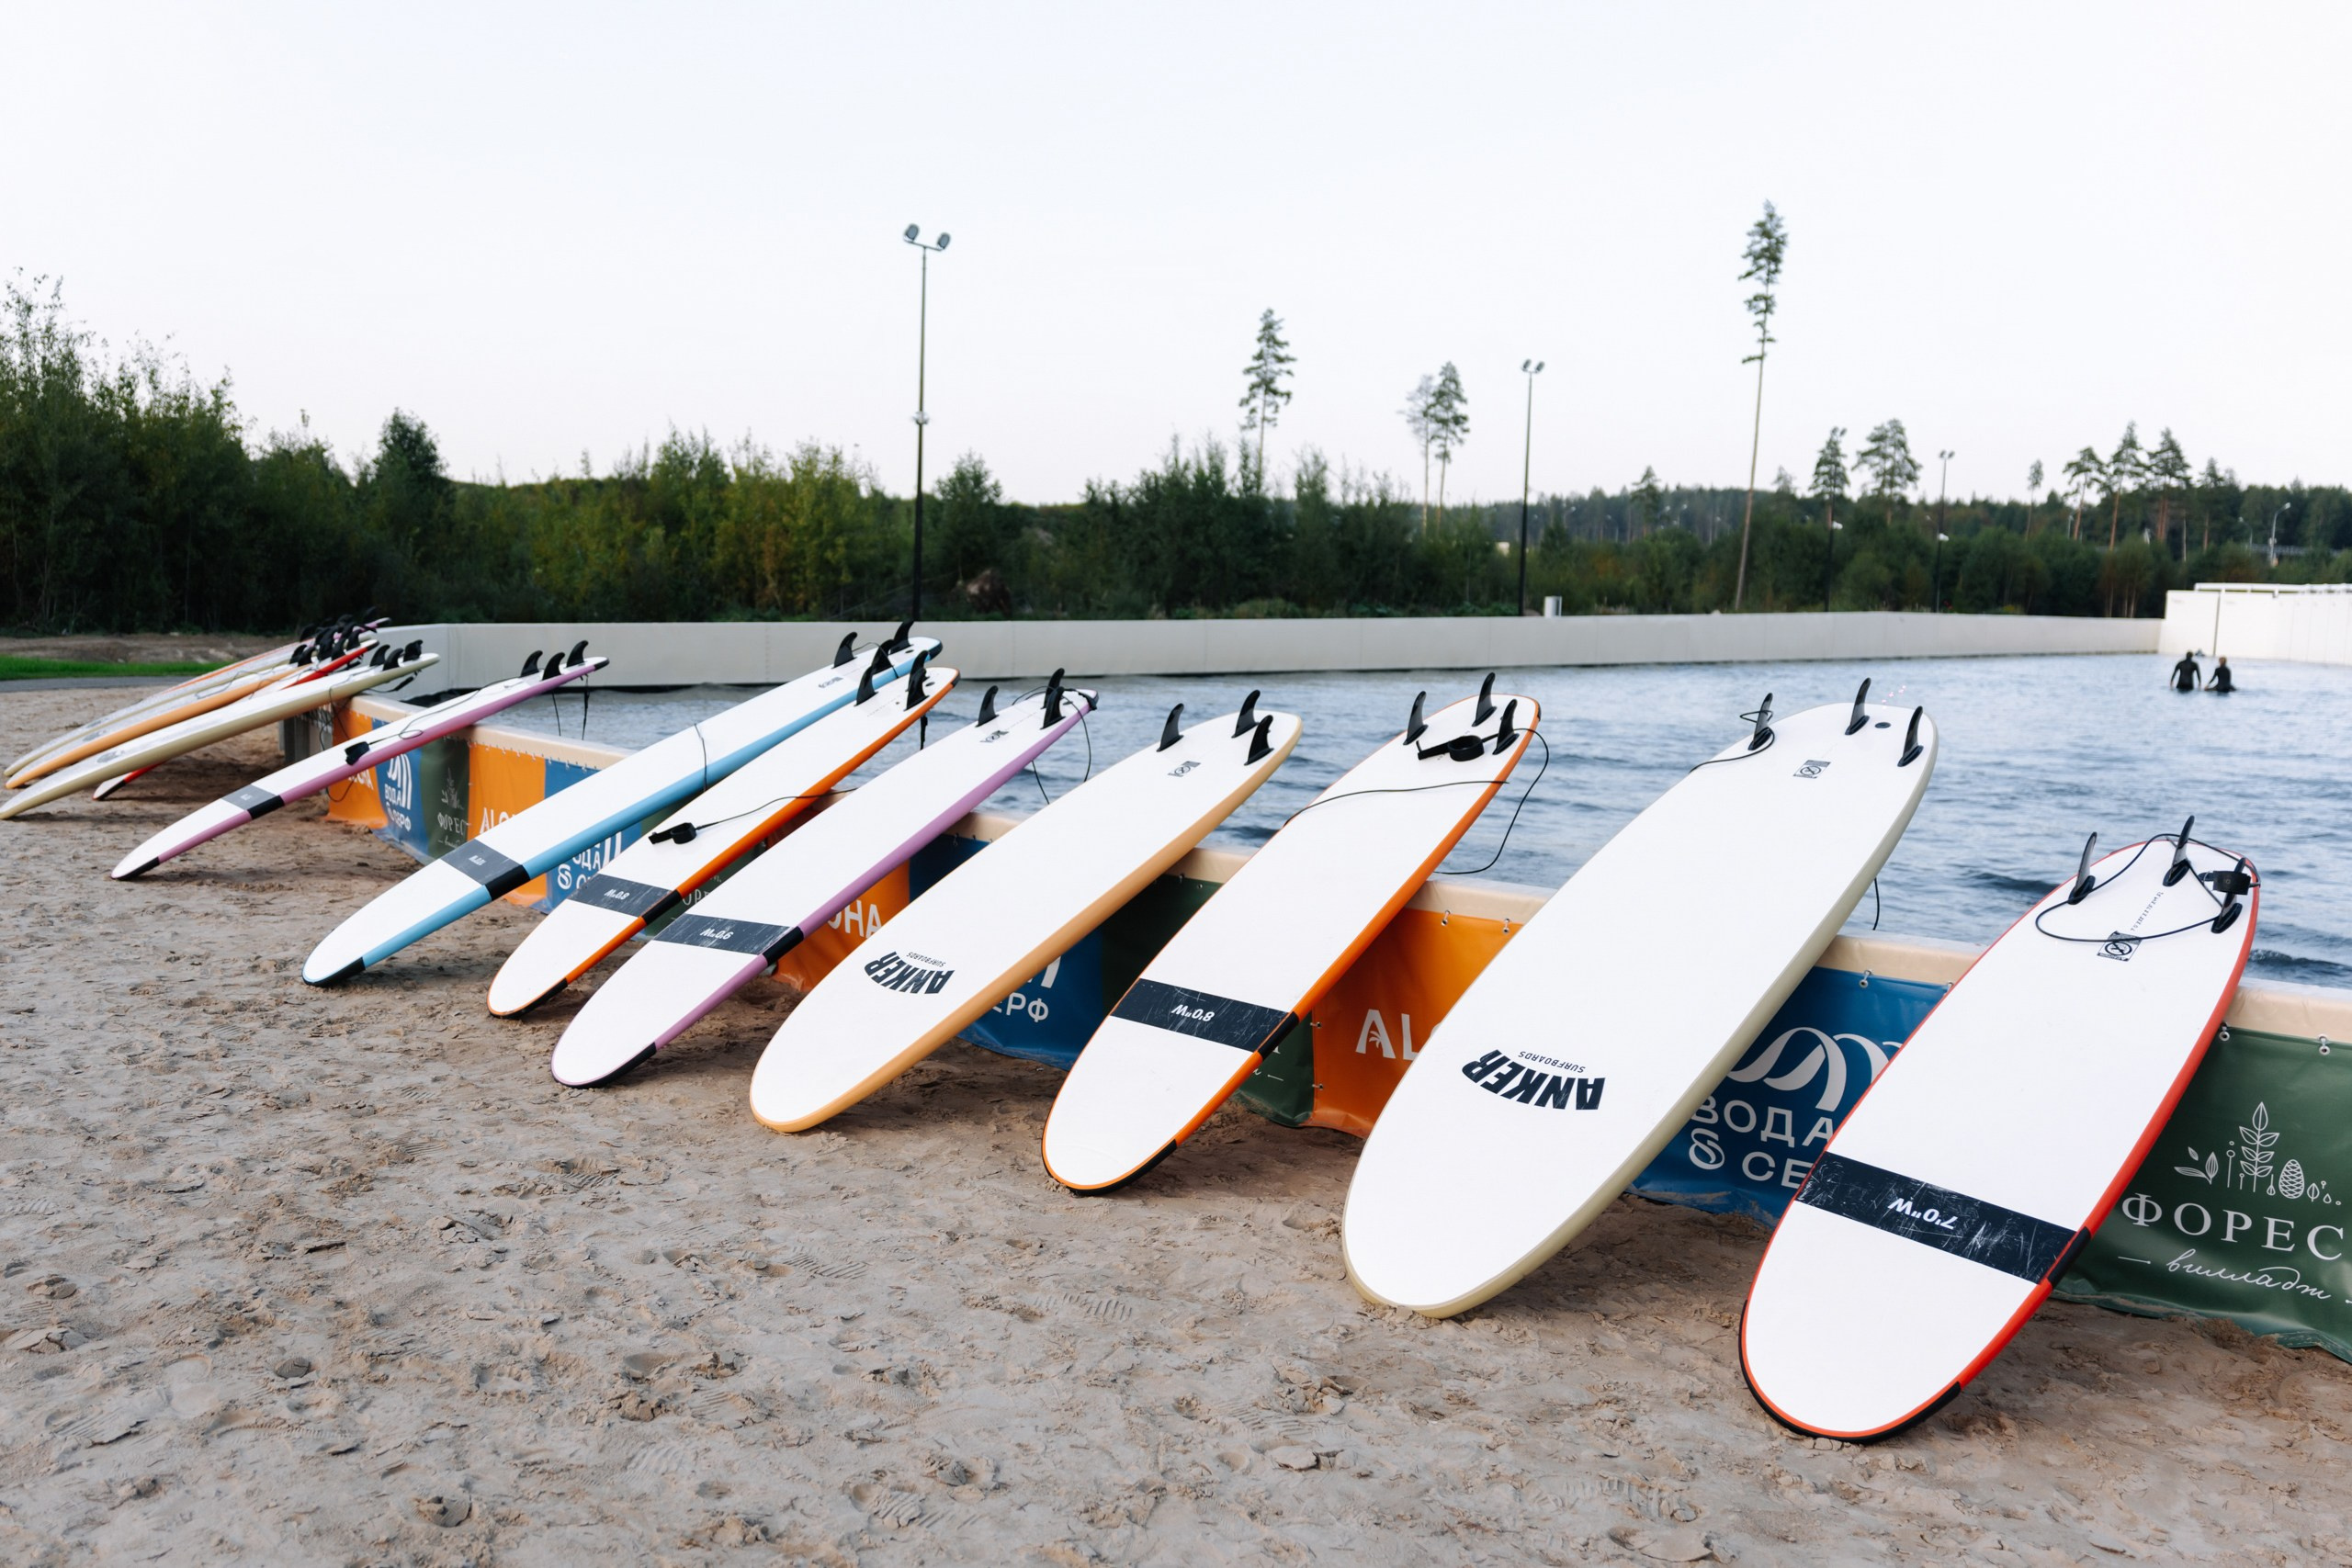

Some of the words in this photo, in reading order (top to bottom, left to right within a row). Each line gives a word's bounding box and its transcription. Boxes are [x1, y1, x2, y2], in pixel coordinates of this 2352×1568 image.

[864, 952, 956, 995] ANKER
[905, 951, 947, 968] SURFBOARDS
[1170, 1003, 1216, 1021] 8'0"W
[1461, 1049, 1607, 1111] ANKER
[1517, 1050, 1587, 1074] SURFBOARDS
[1690, 1094, 1836, 1148] ВОДА
[1741, 1151, 1815, 1190] СЕ
[1886, 1196, 1959, 1231] 7'0"W
[2120, 1192, 2345, 1261] ФОРЕС
